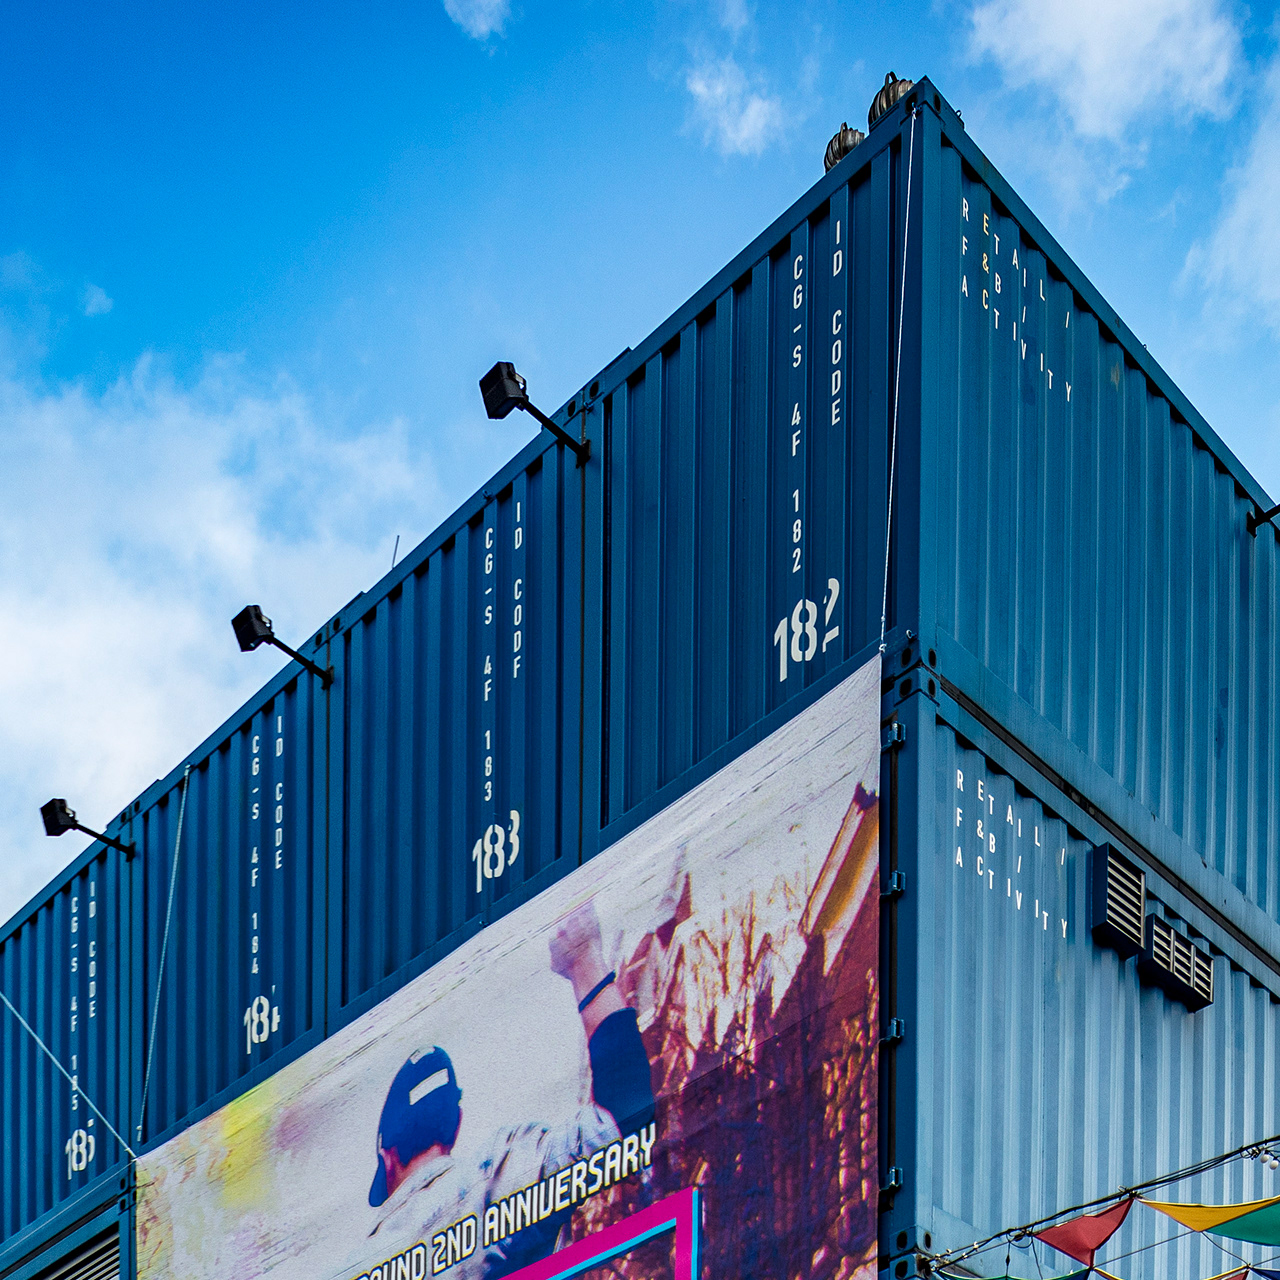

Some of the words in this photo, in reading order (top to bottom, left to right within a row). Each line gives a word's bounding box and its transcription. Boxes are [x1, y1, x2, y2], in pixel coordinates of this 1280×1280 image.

[833, 219, 843, 278] ID
[961, 196, 1046, 302] RETAIL
[831, 309, 842, 426] CODE
[961, 274, 1072, 403] ACTIVITY
[791, 402, 801, 457] 4F
[791, 488, 802, 573] 182
[773, 577, 840, 682] 182
[483, 655, 492, 702] 4F
[484, 730, 492, 802] 183
[956, 768, 1041, 847] RETAIL
[274, 782, 283, 870] CODE
[472, 809, 521, 893] 183
[956, 807, 996, 854] F&B
[955, 846, 1068, 939] ACTIVITY
[431, 1214, 478, 1276] 2ND
[481, 1121, 658, 1247] ANNIVERSARY
